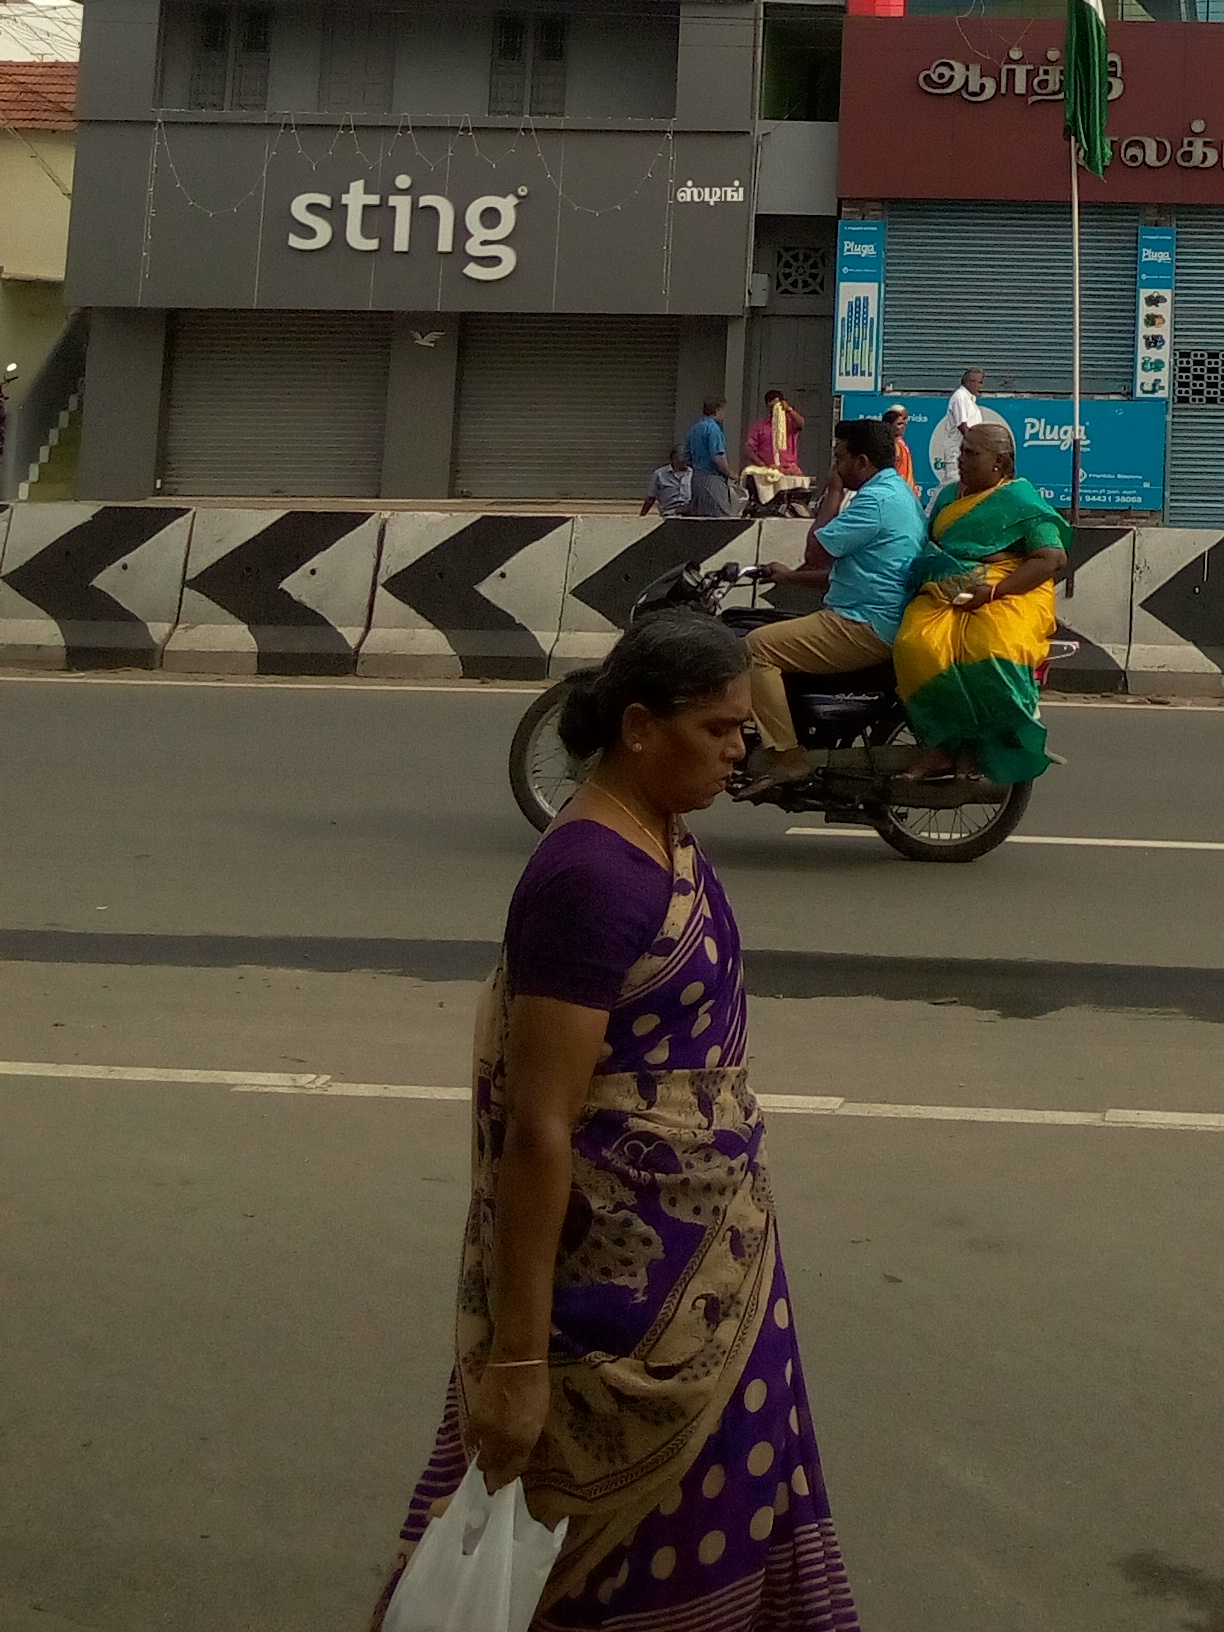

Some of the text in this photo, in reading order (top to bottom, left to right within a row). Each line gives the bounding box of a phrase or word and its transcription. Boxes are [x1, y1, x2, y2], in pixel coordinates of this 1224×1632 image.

[676, 179, 745, 206] ஸ்டிங்
[287, 174, 520, 282] sting
[843, 240, 876, 257] Pluga
[1141, 247, 1171, 264] Pluga
